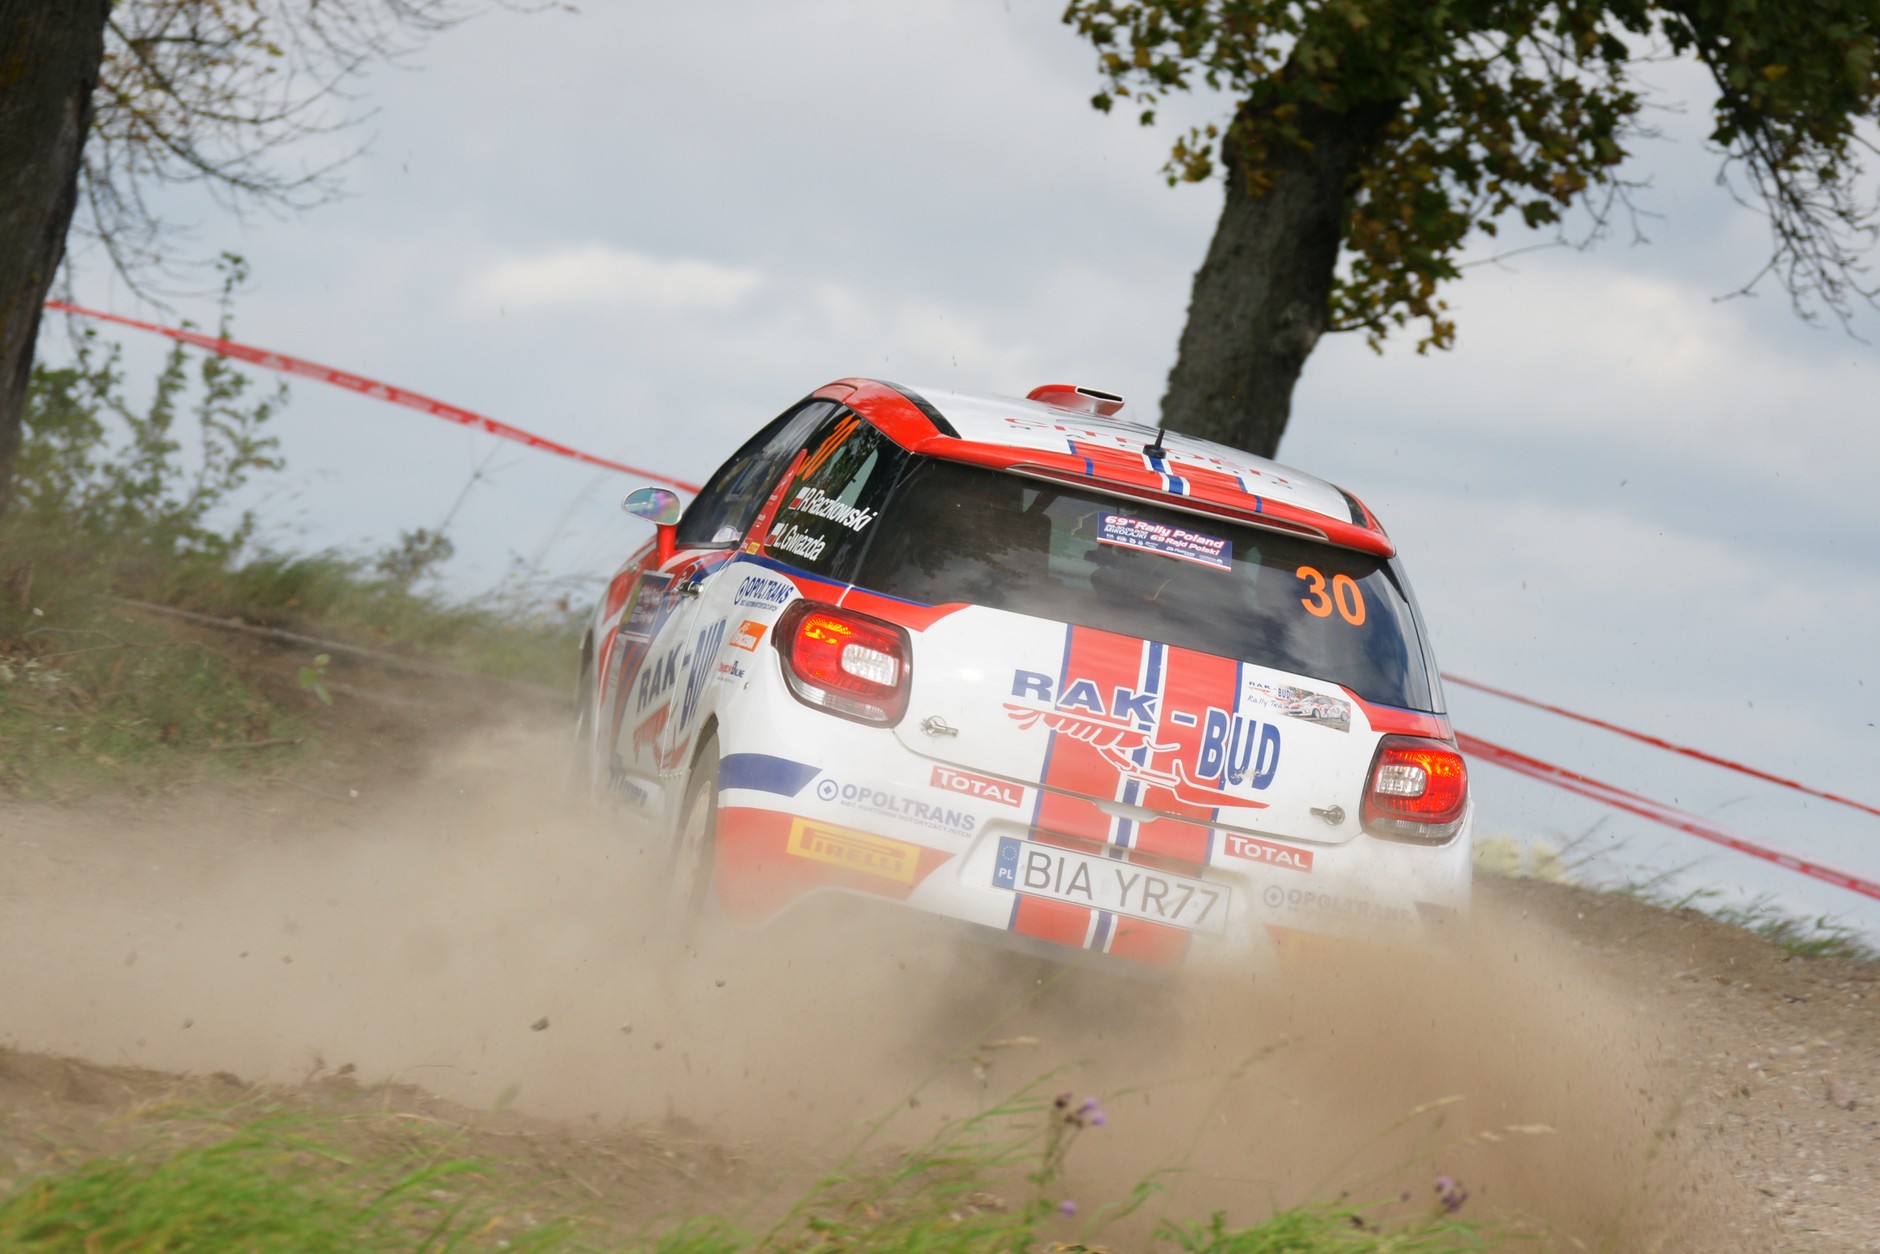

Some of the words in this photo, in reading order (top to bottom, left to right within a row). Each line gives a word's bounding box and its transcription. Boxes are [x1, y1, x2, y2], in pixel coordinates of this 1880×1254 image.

[1135, 521, 1171, 537] Rally
[1173, 529, 1225, 549] Poland
[1165, 537, 1188, 548] Rajd
[1188, 543, 1221, 556] Polski
[1296, 565, 1366, 626] 30
[1247, 695, 1269, 707] Rally
[842, 783, 976, 831] OPOLTRANS
[800, 826, 907, 873] PIRELLI
[998, 867, 1013, 880] PL
[1023, 849, 1094, 901] BIA
[1114, 868, 1220, 925] YR77
